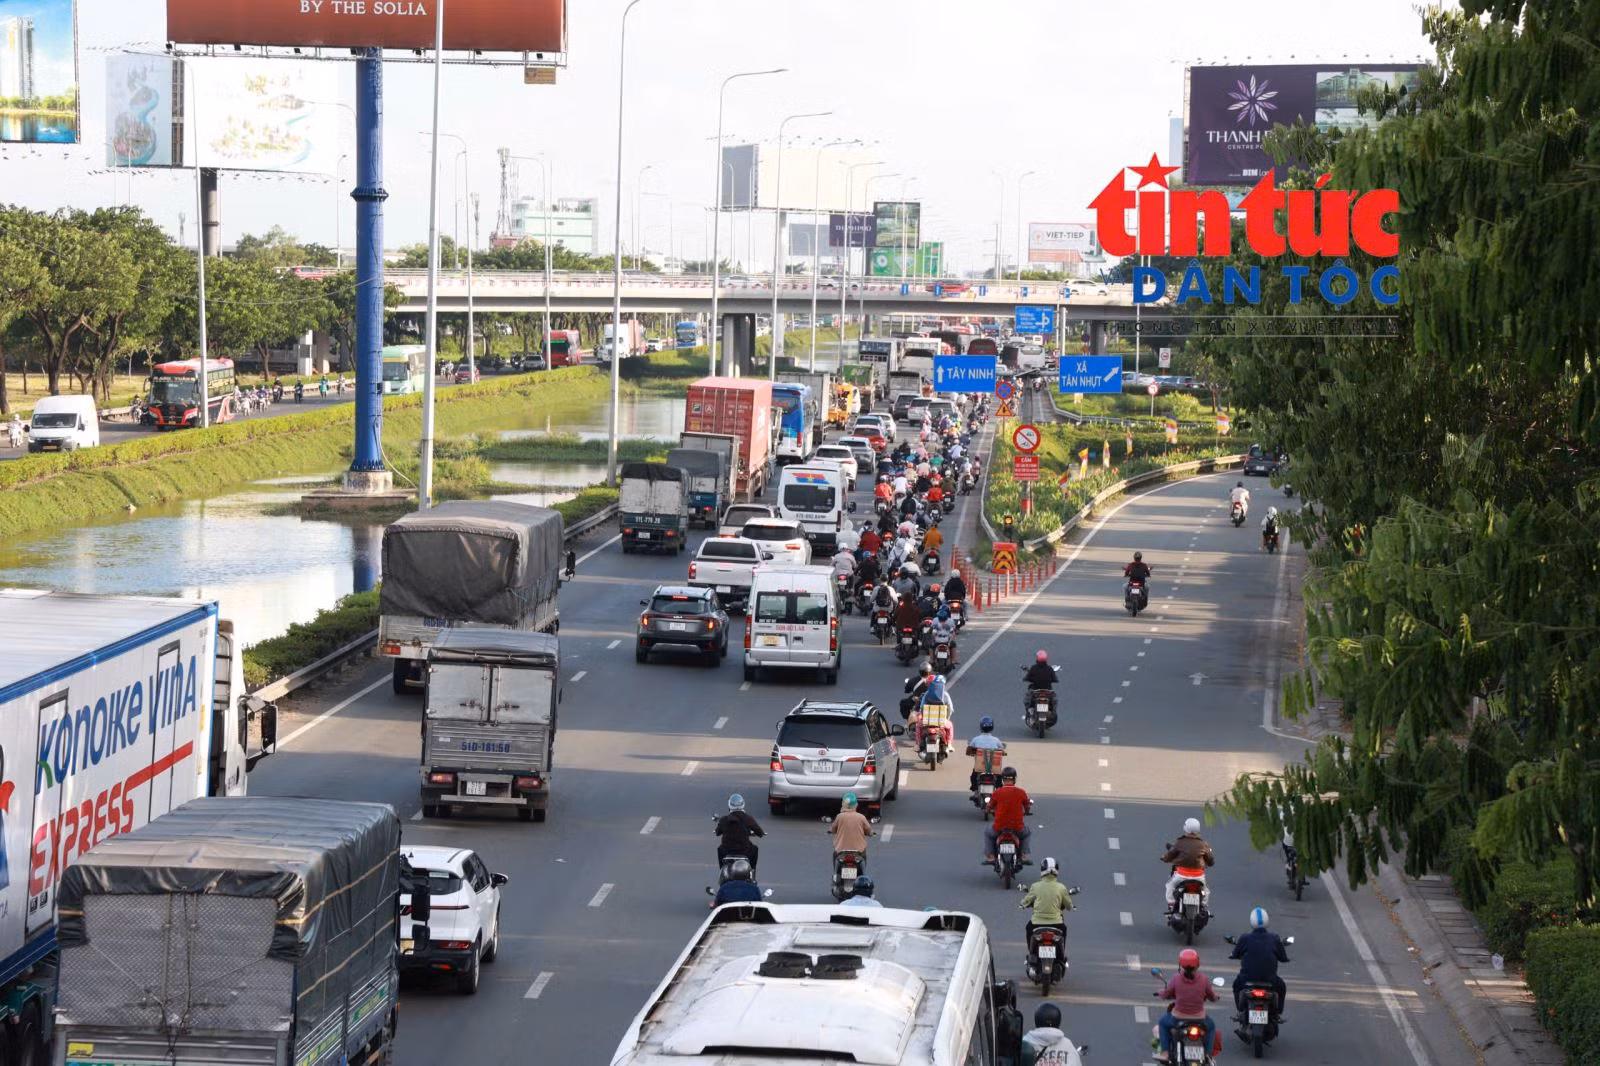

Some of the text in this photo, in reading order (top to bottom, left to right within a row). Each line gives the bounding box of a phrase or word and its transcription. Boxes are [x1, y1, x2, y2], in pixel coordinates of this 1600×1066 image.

[300, 0, 427, 15] BY THE SOLIA
[1206, 130, 1261, 143] THANH
[946, 365, 994, 380] TÂY NINH
[1061, 373, 1079, 387] TÂN
[30, 770, 150, 897] EXPRESS
